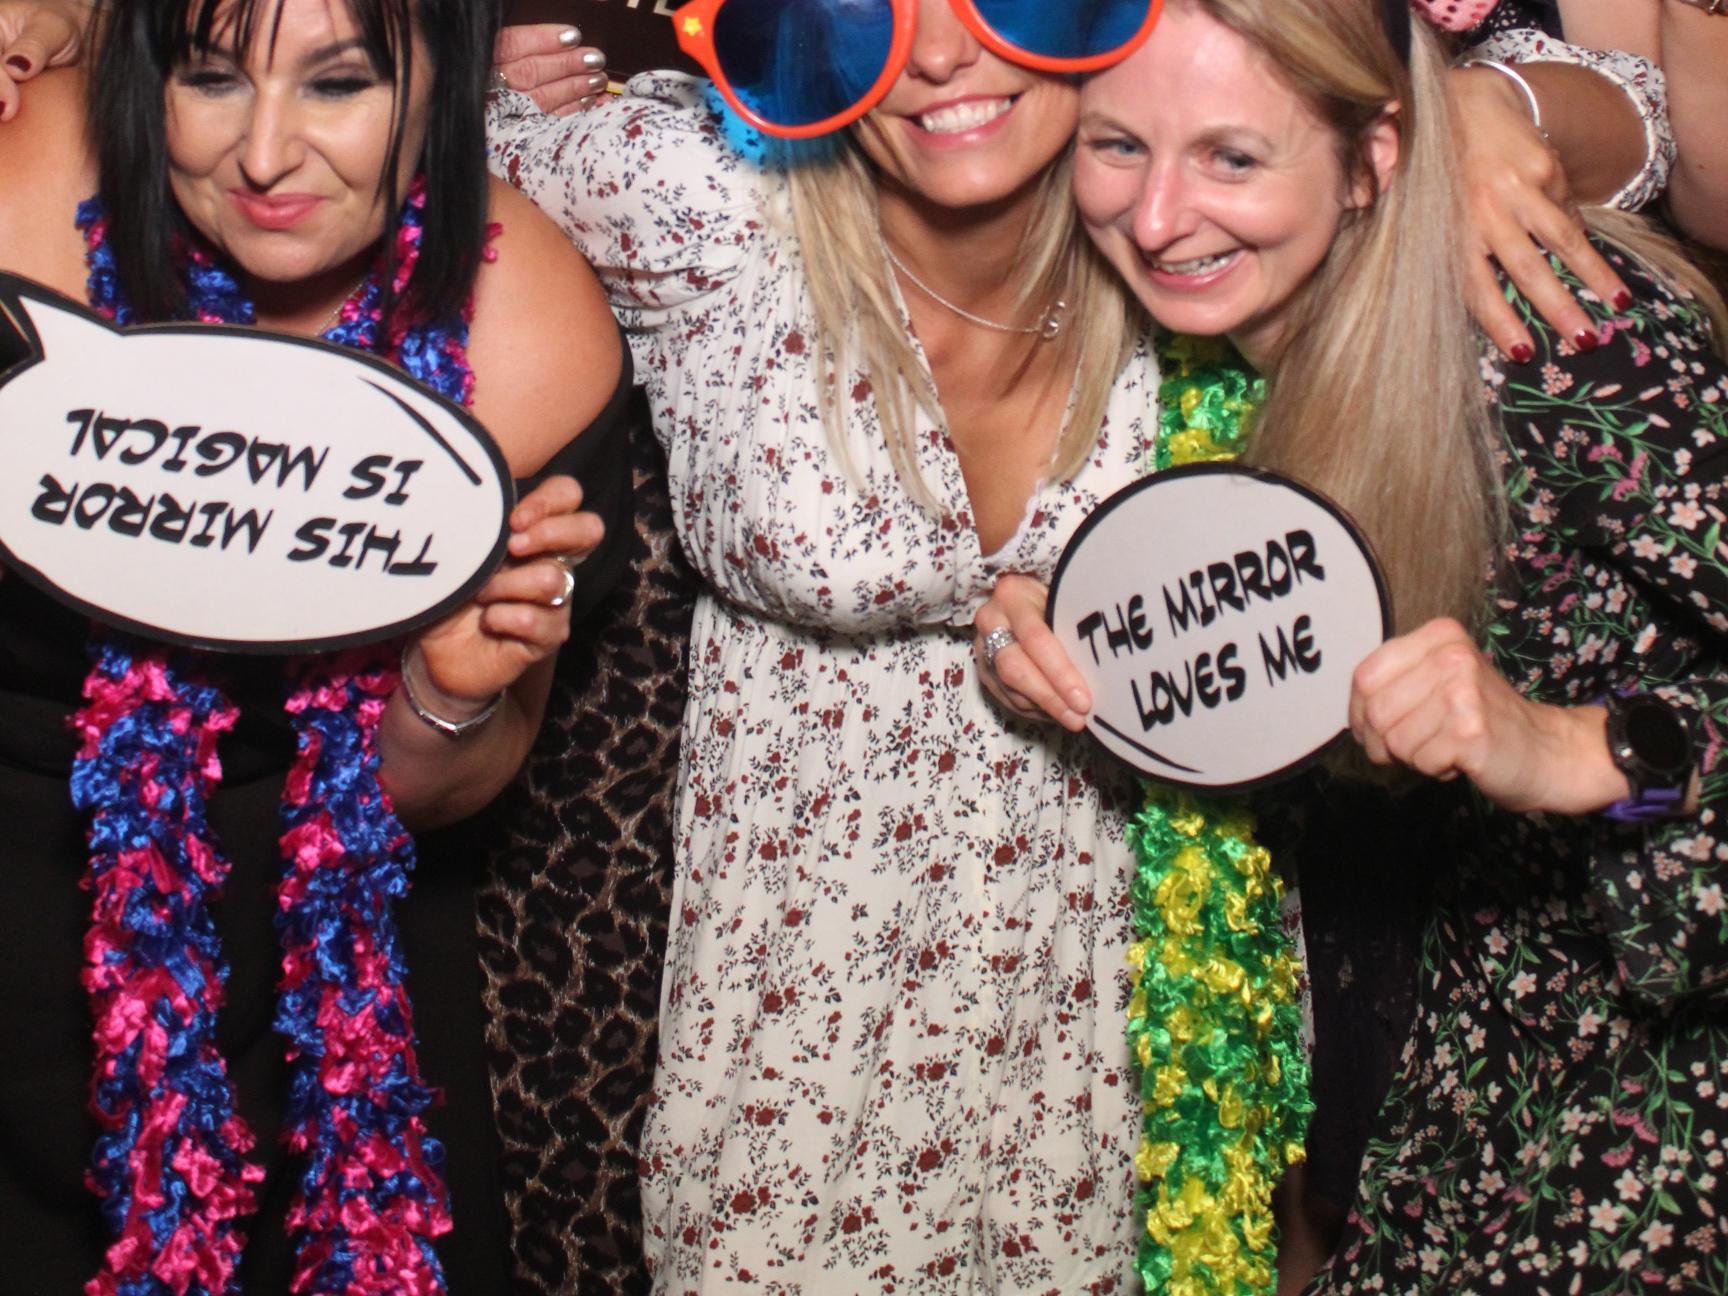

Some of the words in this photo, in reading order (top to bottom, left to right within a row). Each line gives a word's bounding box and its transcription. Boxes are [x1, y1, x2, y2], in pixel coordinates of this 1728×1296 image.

[66, 409, 330, 492] MAGICAL
[342, 455, 424, 506] IS
[31, 473, 274, 554] MIRROR
[287, 517, 438, 576] THIS
[1076, 594, 1153, 667] THE
[1162, 529, 1325, 638] MIRROR
[1130, 642, 1246, 732] LOVES
[1257, 614, 1322, 687] ME
